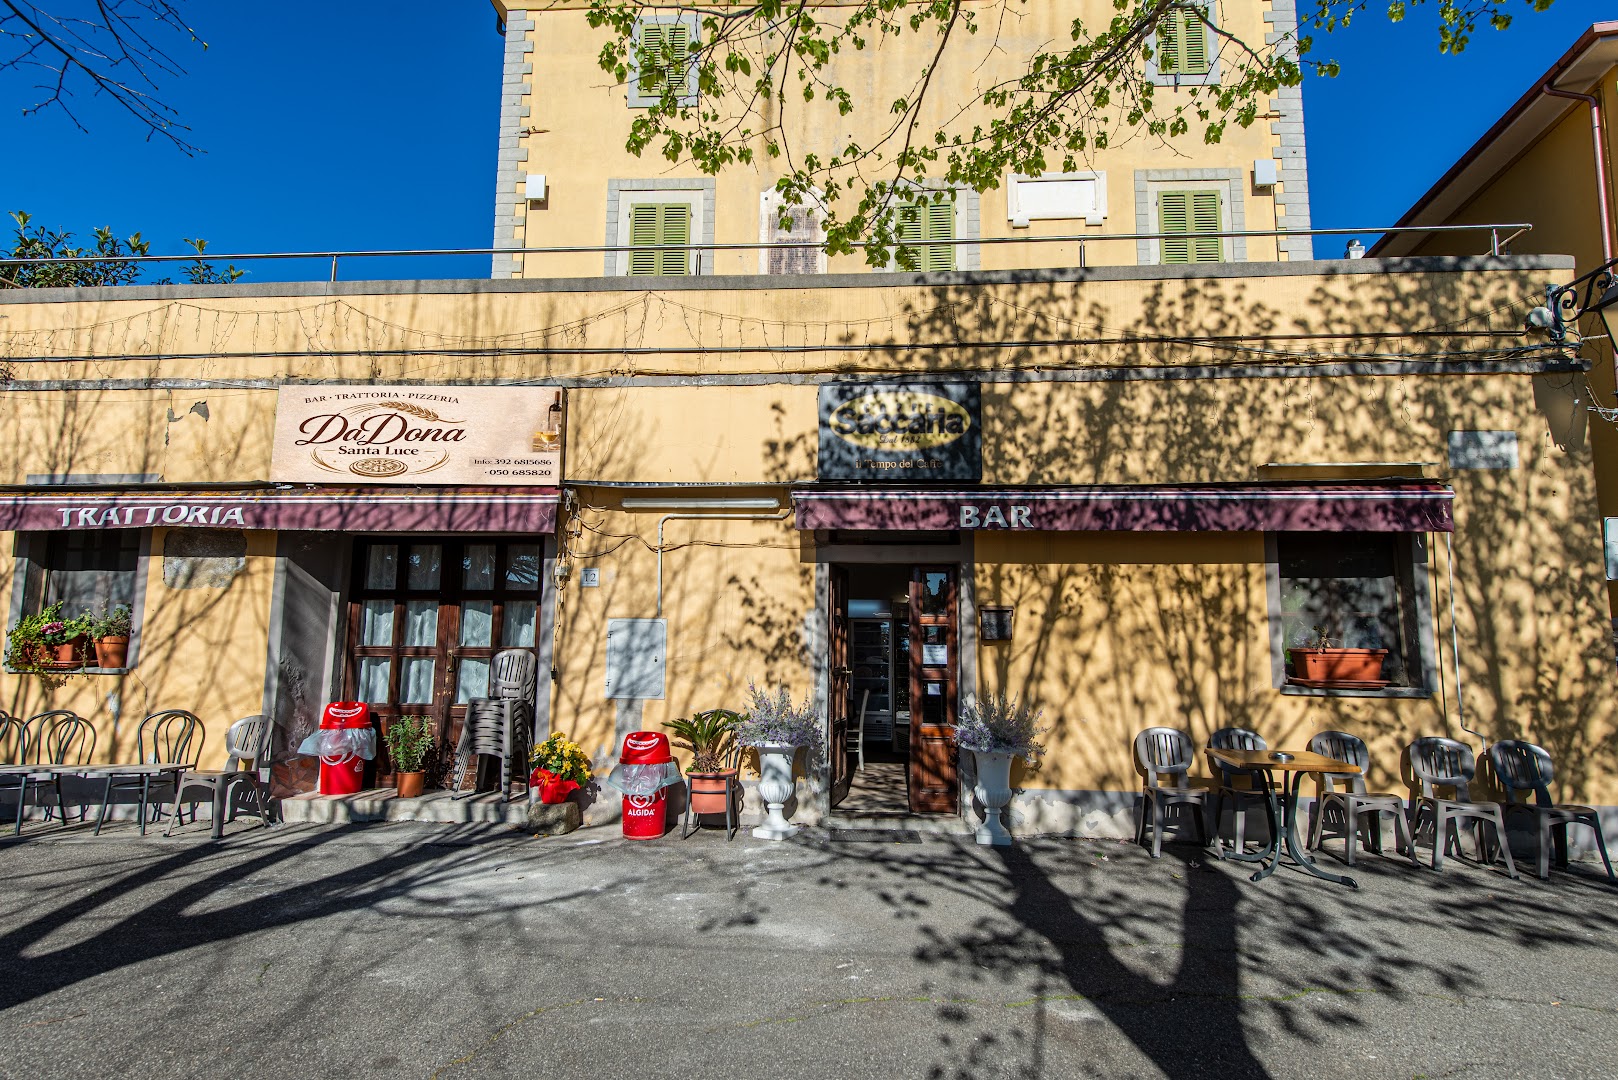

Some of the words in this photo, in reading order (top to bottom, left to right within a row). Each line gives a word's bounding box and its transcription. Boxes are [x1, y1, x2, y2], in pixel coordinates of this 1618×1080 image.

[304, 395, 327, 404] BAR
[335, 392, 400, 400] TRATTORIA
[408, 392, 460, 404] PIZZERIA
[834, 406, 965, 435] Saccaria
[879, 434, 899, 444] Dal
[338, 445, 380, 455] Santa
[385, 446, 420, 456] Luce
[864, 459, 897, 471] Tempo
[899, 458, 914, 469] del
[57, 505, 245, 527] TRATTORIA
[960, 505, 1035, 528] BAR
[584, 572, 597, 583] 12
[627, 808, 656, 817] ALGIDA
